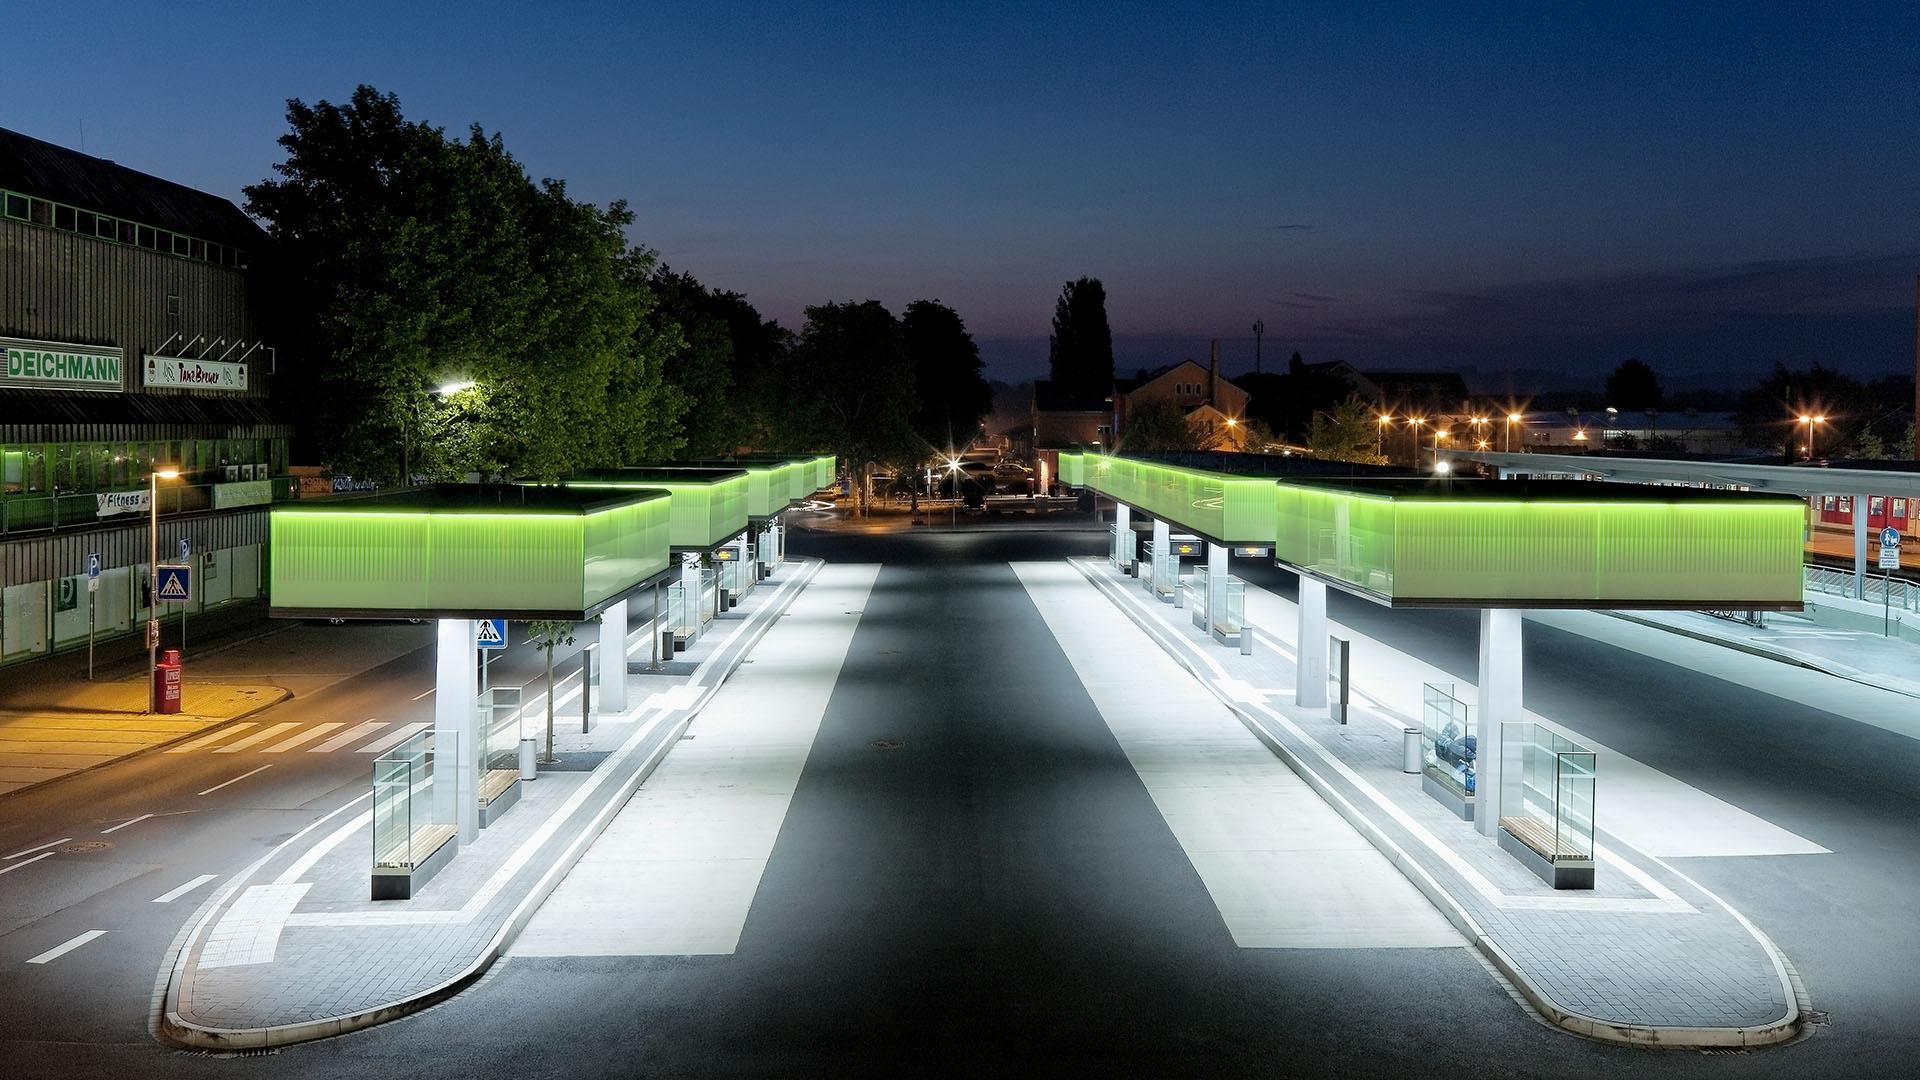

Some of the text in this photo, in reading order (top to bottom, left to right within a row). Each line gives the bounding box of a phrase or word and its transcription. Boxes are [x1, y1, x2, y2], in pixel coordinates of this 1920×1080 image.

[8, 350, 119, 381] DEICHMANN
[107, 494, 140, 507] Fitness
[182, 541, 188, 558] P
[90, 557, 98, 575] P
